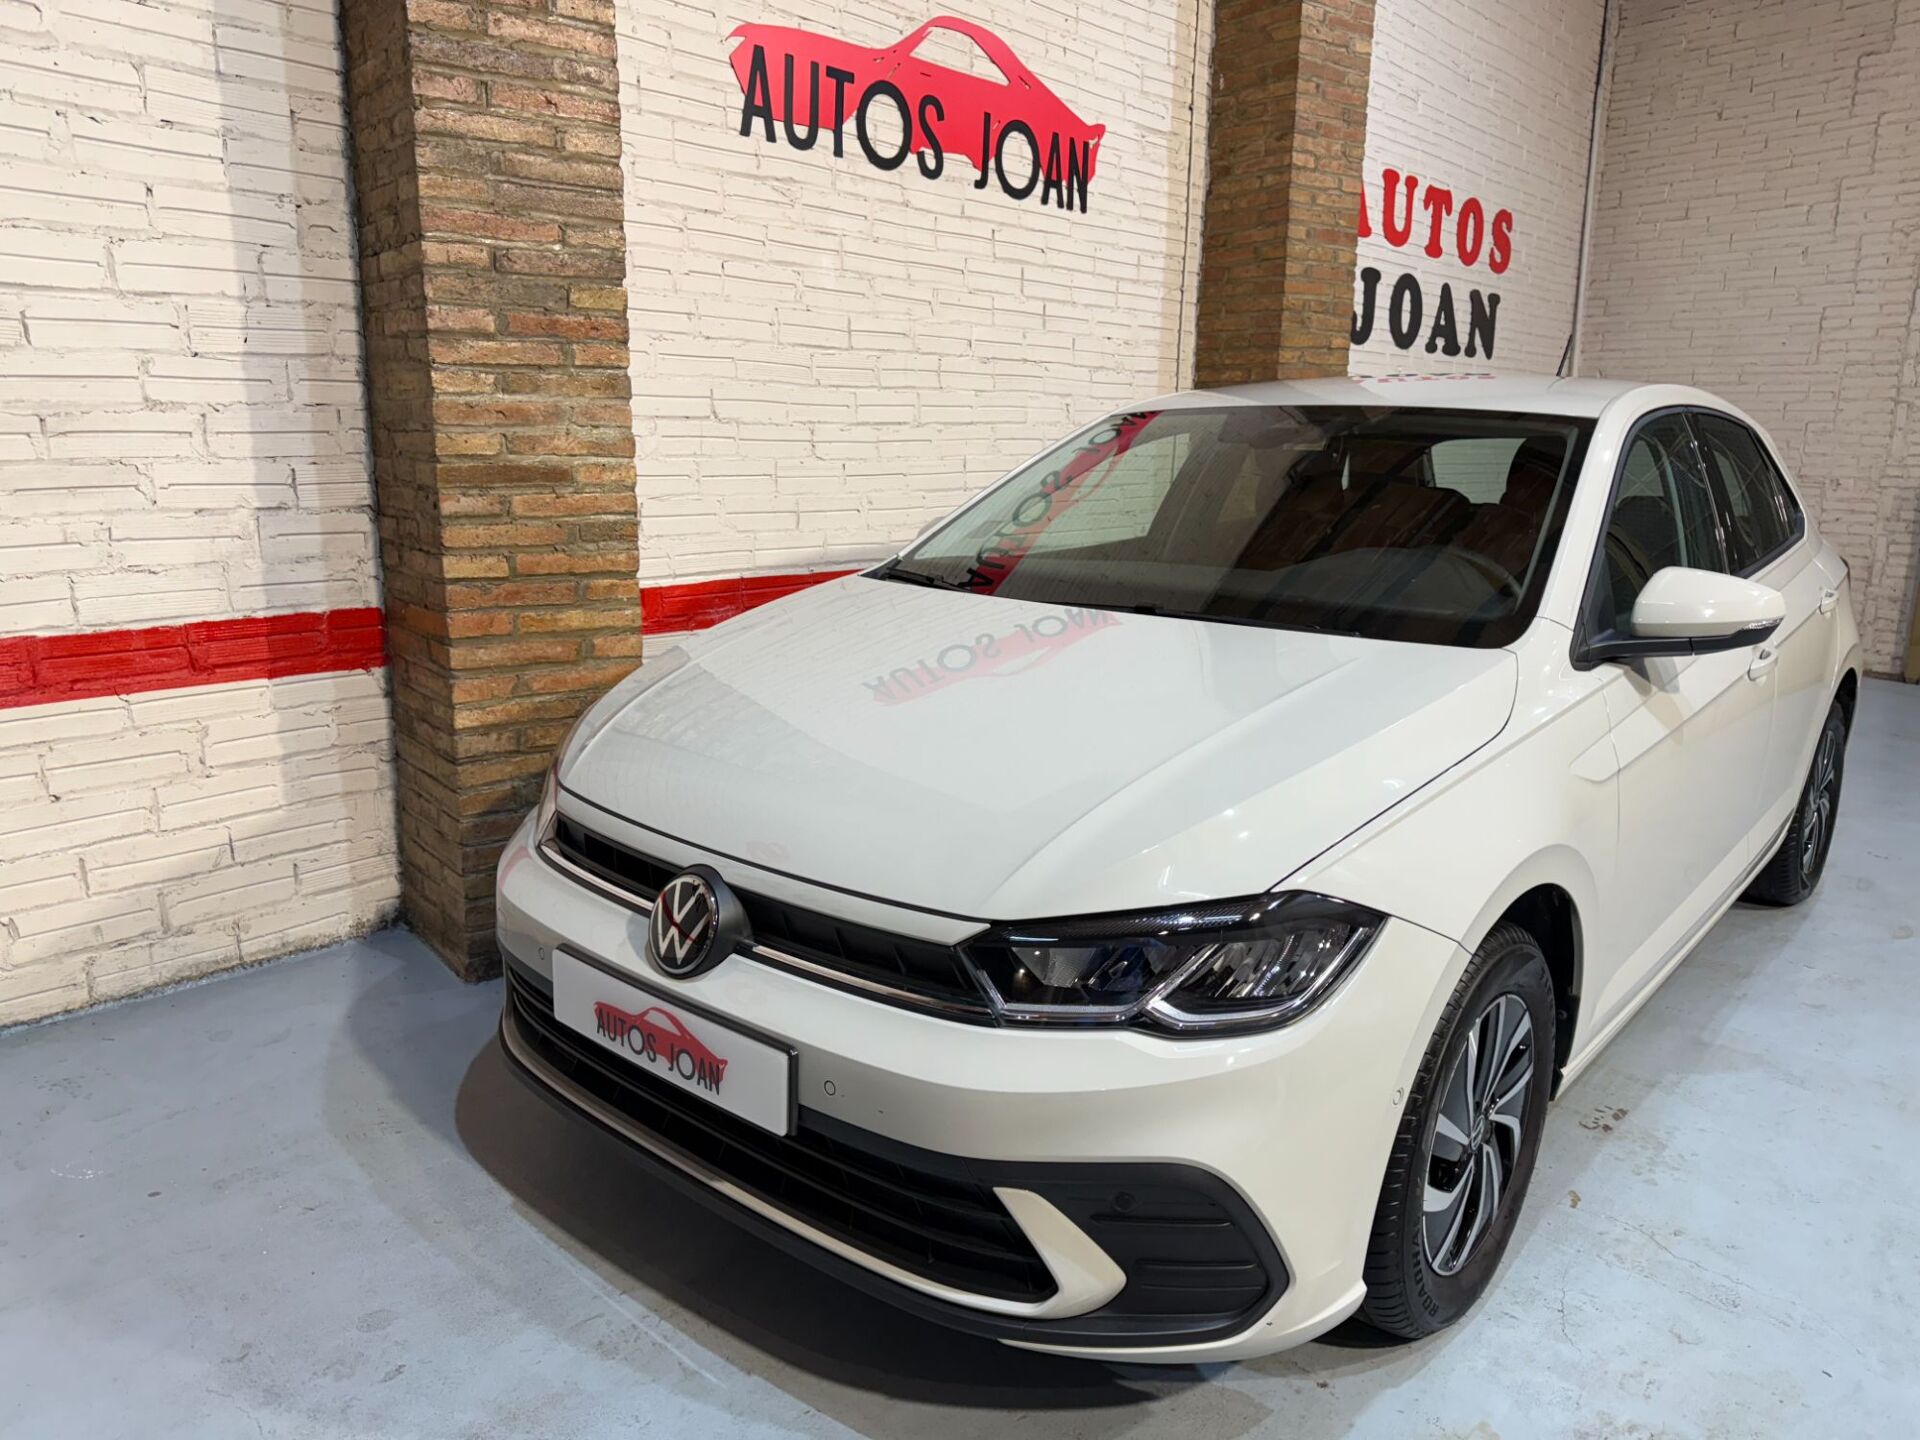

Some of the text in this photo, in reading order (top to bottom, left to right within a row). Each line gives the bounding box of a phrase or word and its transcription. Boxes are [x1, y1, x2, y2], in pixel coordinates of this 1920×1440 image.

[740, 45, 1090, 214] AUTOS JOAN
[1350, 267, 1501, 360] JOAN
[596, 1007, 720, 1096] AUTOS JOAN
